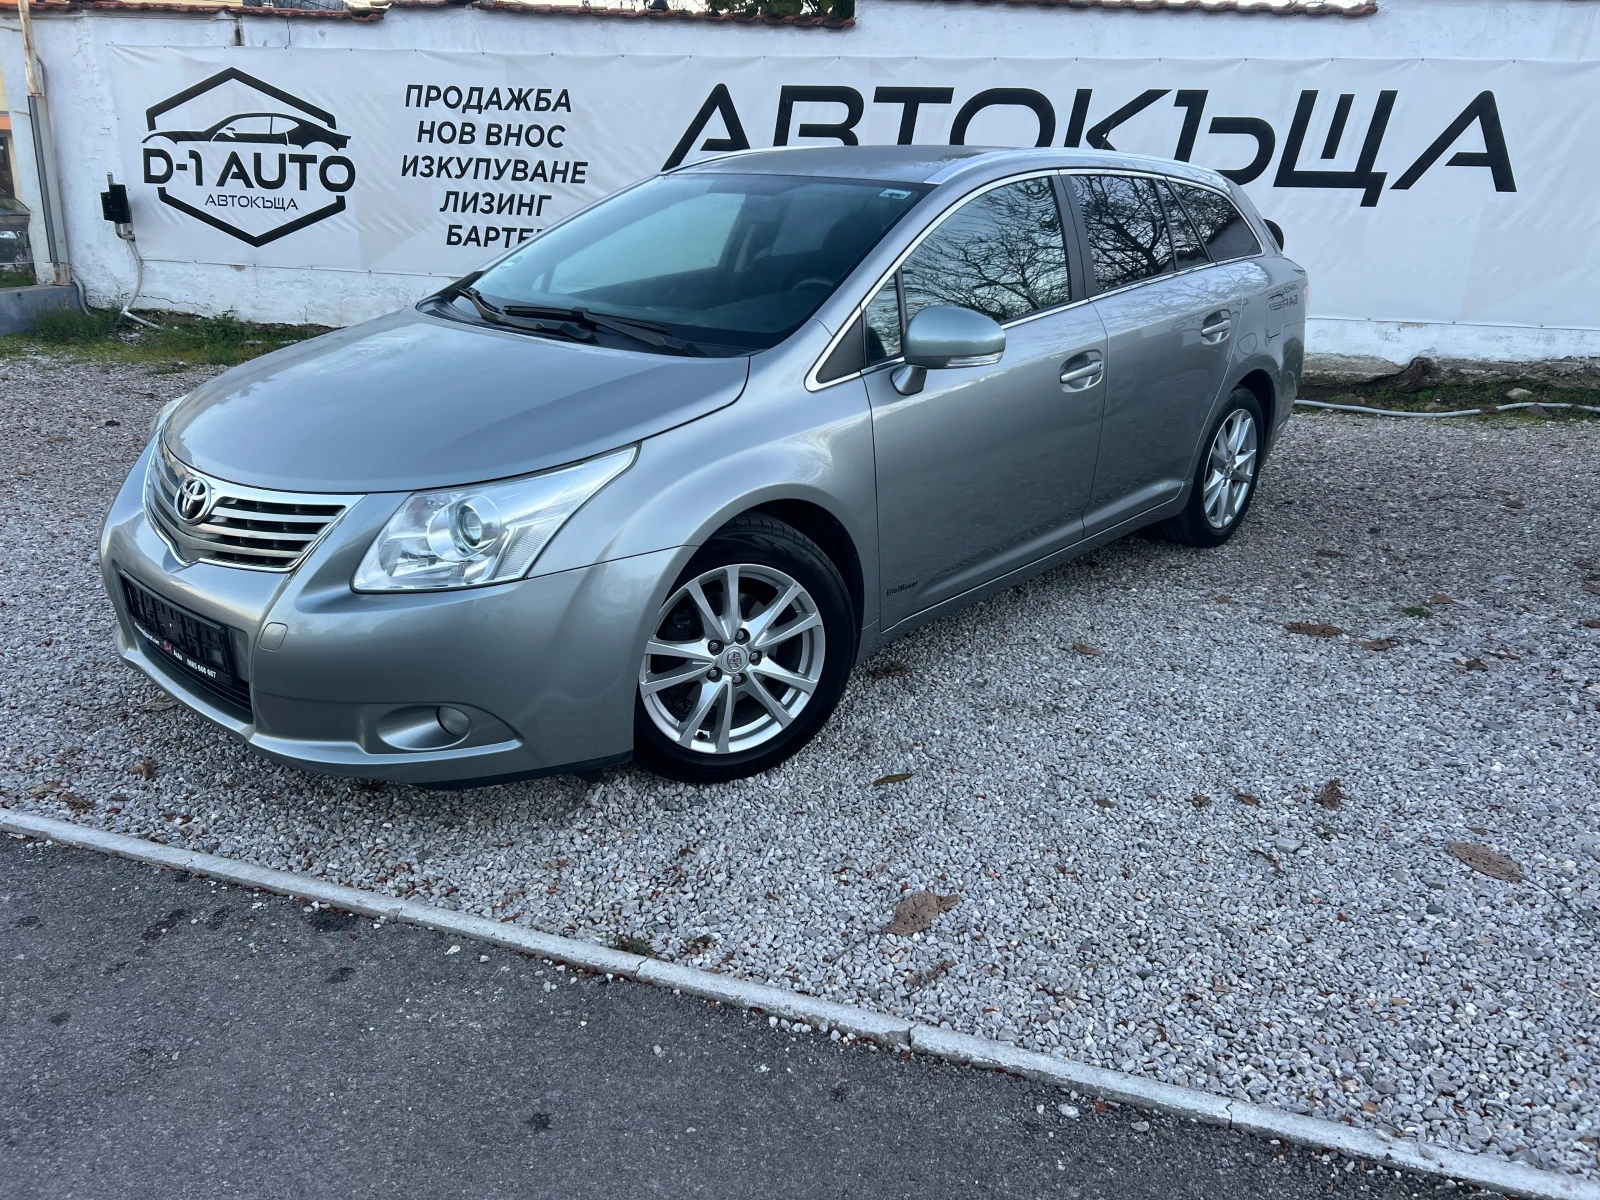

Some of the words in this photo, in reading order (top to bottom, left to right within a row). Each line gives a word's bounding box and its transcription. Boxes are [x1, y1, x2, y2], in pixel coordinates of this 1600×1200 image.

[405, 84, 572, 114] ПРОДАЖБА
[417, 121, 476, 146] НОВ
[485, 122, 566, 149] ВНОС
[660, 83, 1517, 206] АВТОКЪЩА
[143, 147, 204, 187] D-1
[216, 151, 356, 193] AUTO
[401, 154, 588, 185] ИЗКУПУВАНЕ
[205, 194, 299, 212] АВТОКЪЩА
[440, 190, 552, 217] ЛИЗИНГ
[446, 223, 545, 248] БАРТЕ
